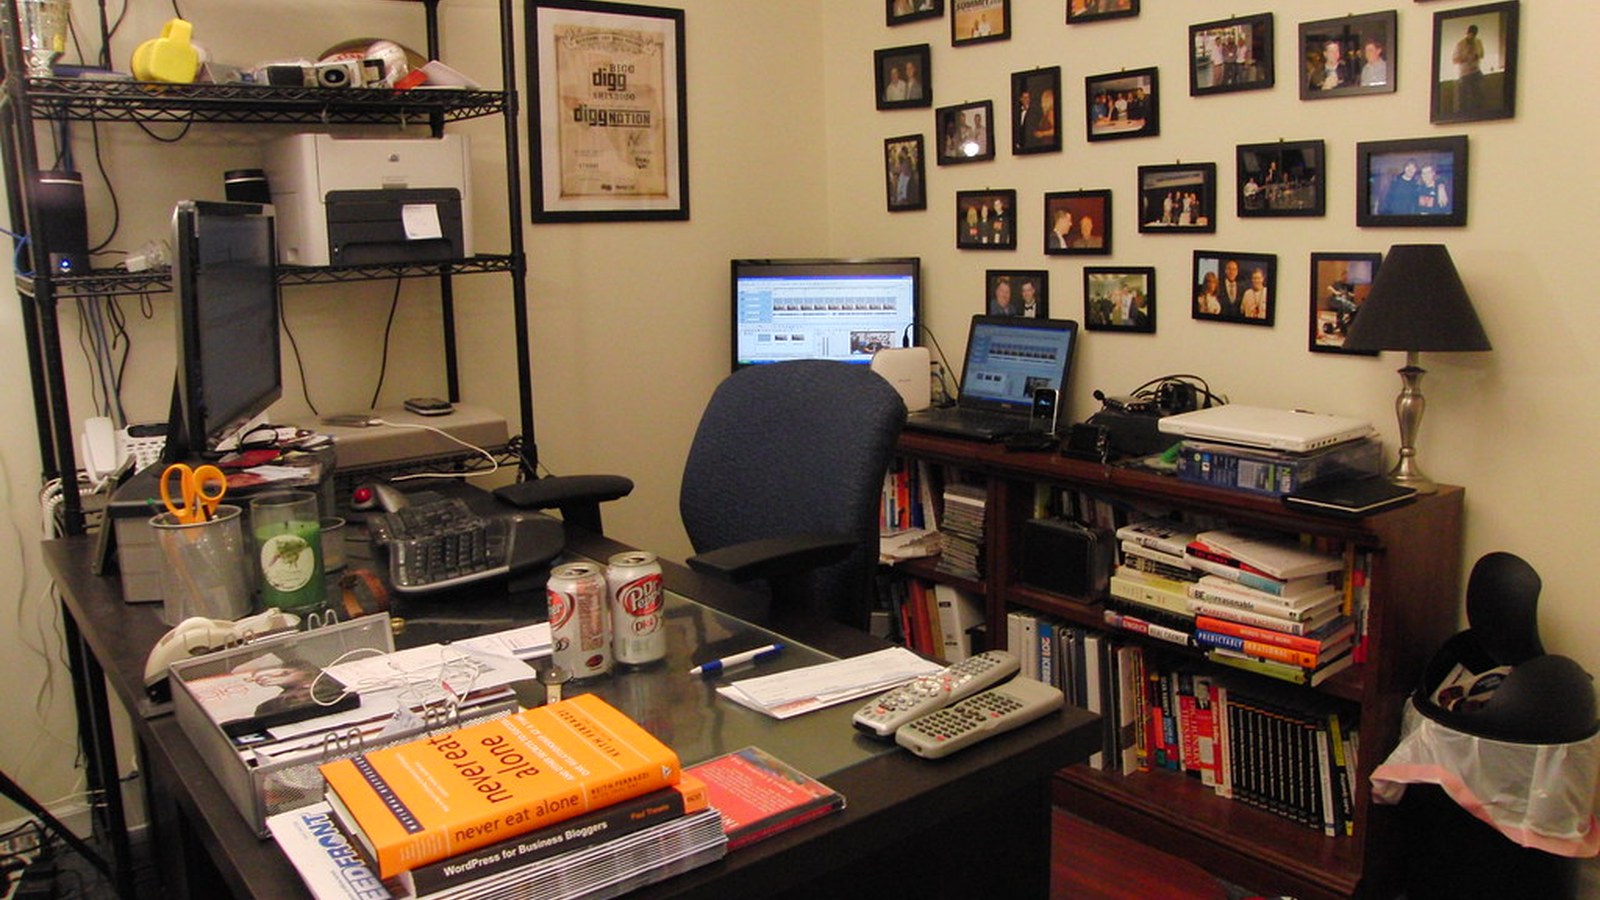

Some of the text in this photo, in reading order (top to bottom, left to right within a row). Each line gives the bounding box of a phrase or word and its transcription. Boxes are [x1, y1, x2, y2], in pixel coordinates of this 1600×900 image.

[592, 67, 627, 91] digg
[1198, 632, 1243, 649] PREDICTABLY
[427, 735, 468, 763] eat
[481, 735, 540, 779] alone
[453, 760, 513, 804] never
[455, 819, 500, 842] never
[505, 809, 533, 826] eat
[536, 793, 579, 818] alone
[303, 813, 392, 900] EEDFRONT
[443, 821, 608, 877] WordPress for Business Bloggers
